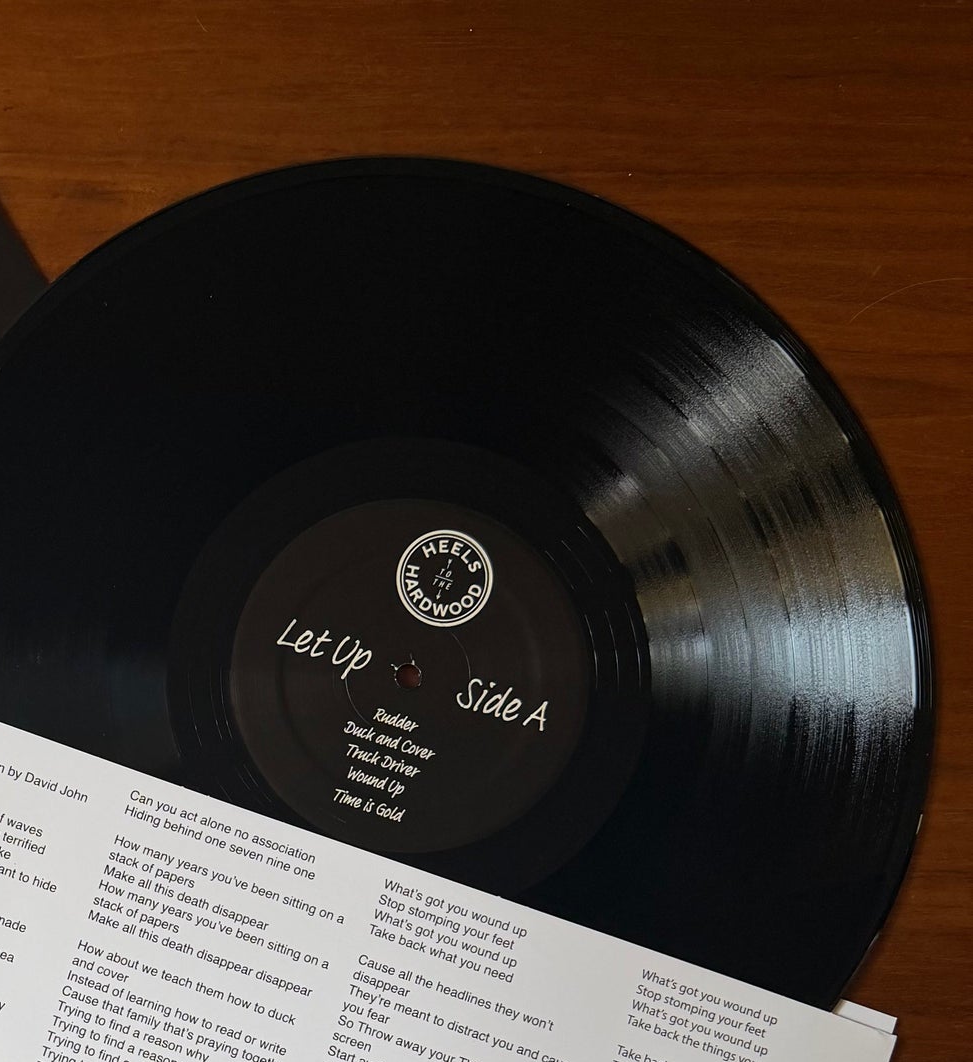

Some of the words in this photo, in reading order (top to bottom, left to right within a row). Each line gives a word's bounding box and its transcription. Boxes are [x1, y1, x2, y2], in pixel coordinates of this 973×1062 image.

[422, 539, 481, 573] HEELS
[439, 569, 451, 578] TO
[405, 564, 482, 617] HARDWOOD
[433, 579, 453, 591] THE
[277, 619, 332, 657] Let
[331, 636, 372, 679] Up
[373, 708, 419, 732] Rudder
[456, 678, 521, 722] Side
[523, 701, 548, 731] A
[344, 720, 374, 742] Duck
[375, 731, 398, 750] and
[401, 738, 436, 761] Cover
[346, 744, 379, 765] Truck
[380, 755, 421, 778] Driver
[7, 766, 23, 781] by
[24, 772, 58, 792] David
[59, 785, 88, 803] John
[347, 766, 386, 790] Wound
[387, 781, 405, 798] Up
[333, 788, 363, 810] Time
[363, 797, 375, 813] is
[376, 804, 406, 822] Gold
[7, 818, 43, 837] waves
[124, 804, 161, 828] Hiding
[163, 818, 203, 840] behind
[204, 835, 227, 849] one
[229, 844, 264, 862] seven
[265, 857, 291, 872] nine
[293, 867, 315, 880] one
[378, 894, 405, 913] Stop
[407, 906, 461, 933] stomping
[462, 925, 490, 940] your
[491, 933, 515, 950] feet
[370, 923, 396, 942] Take
[398, 934, 427, 953] back
[430, 947, 457, 964] what
[458, 958, 481, 972] you
[483, 967, 514, 983] need
[628, 1014, 652, 1032] Take
[653, 1023, 680, 1042] back
[682, 1035, 700, 1049] the
[702, 1042, 736, 1062] things
